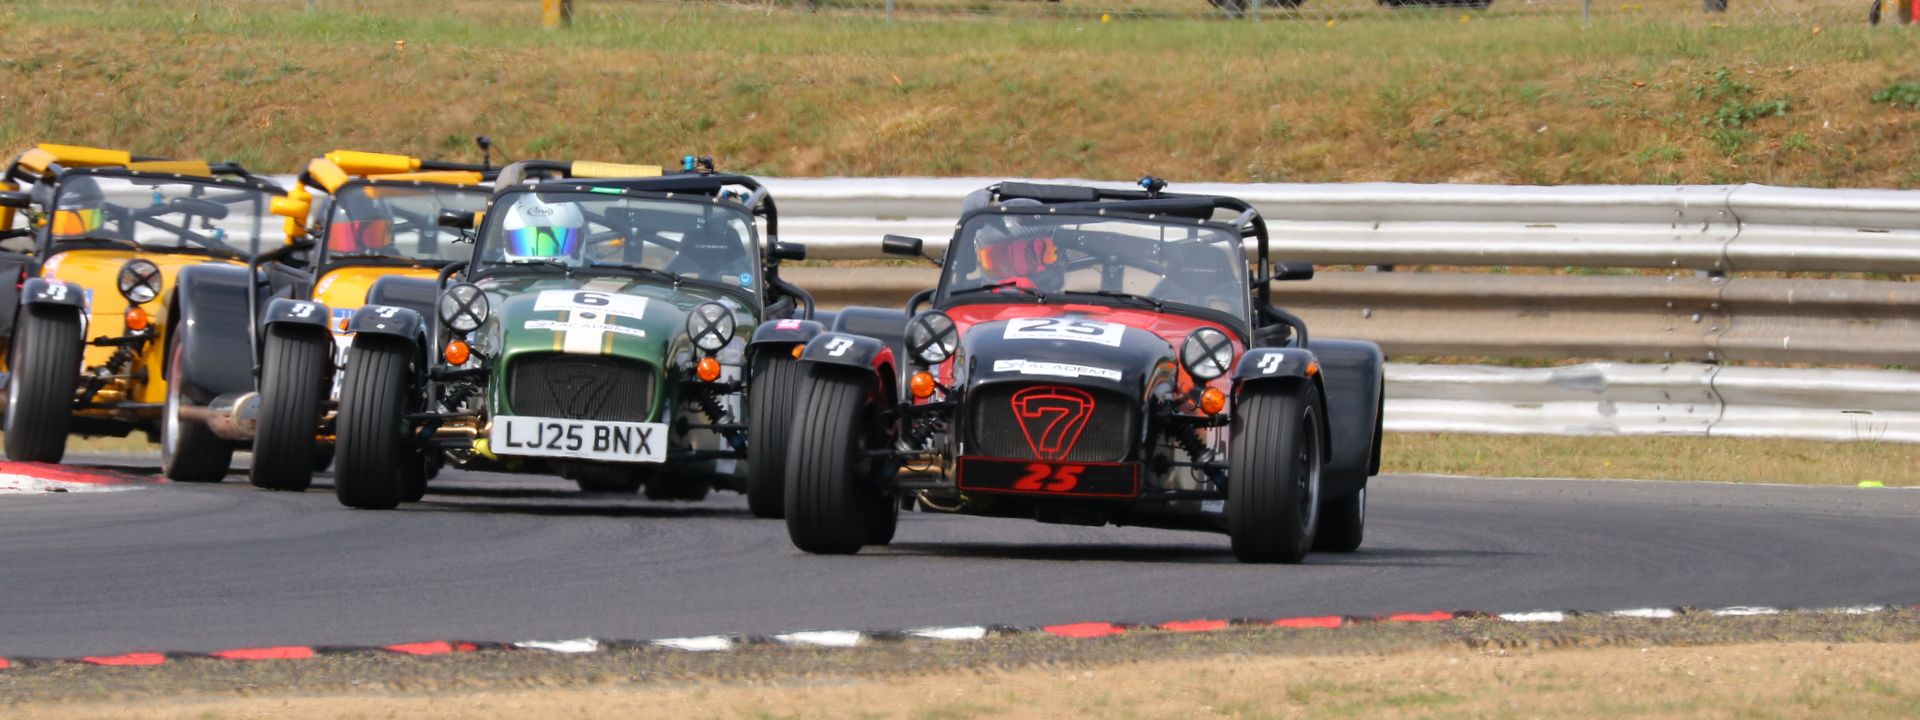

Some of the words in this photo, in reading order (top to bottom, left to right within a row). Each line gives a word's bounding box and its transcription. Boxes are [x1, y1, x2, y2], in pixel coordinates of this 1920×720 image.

[572, 291, 610, 306] 6
[1018, 318, 1108, 336] 25
[1028, 362, 1118, 377] ACADEMY
[1022, 394, 1084, 453] 7
[506, 421, 584, 451] LJ25
[593, 425, 653, 455] BNX
[1012, 463, 1087, 492] 25
